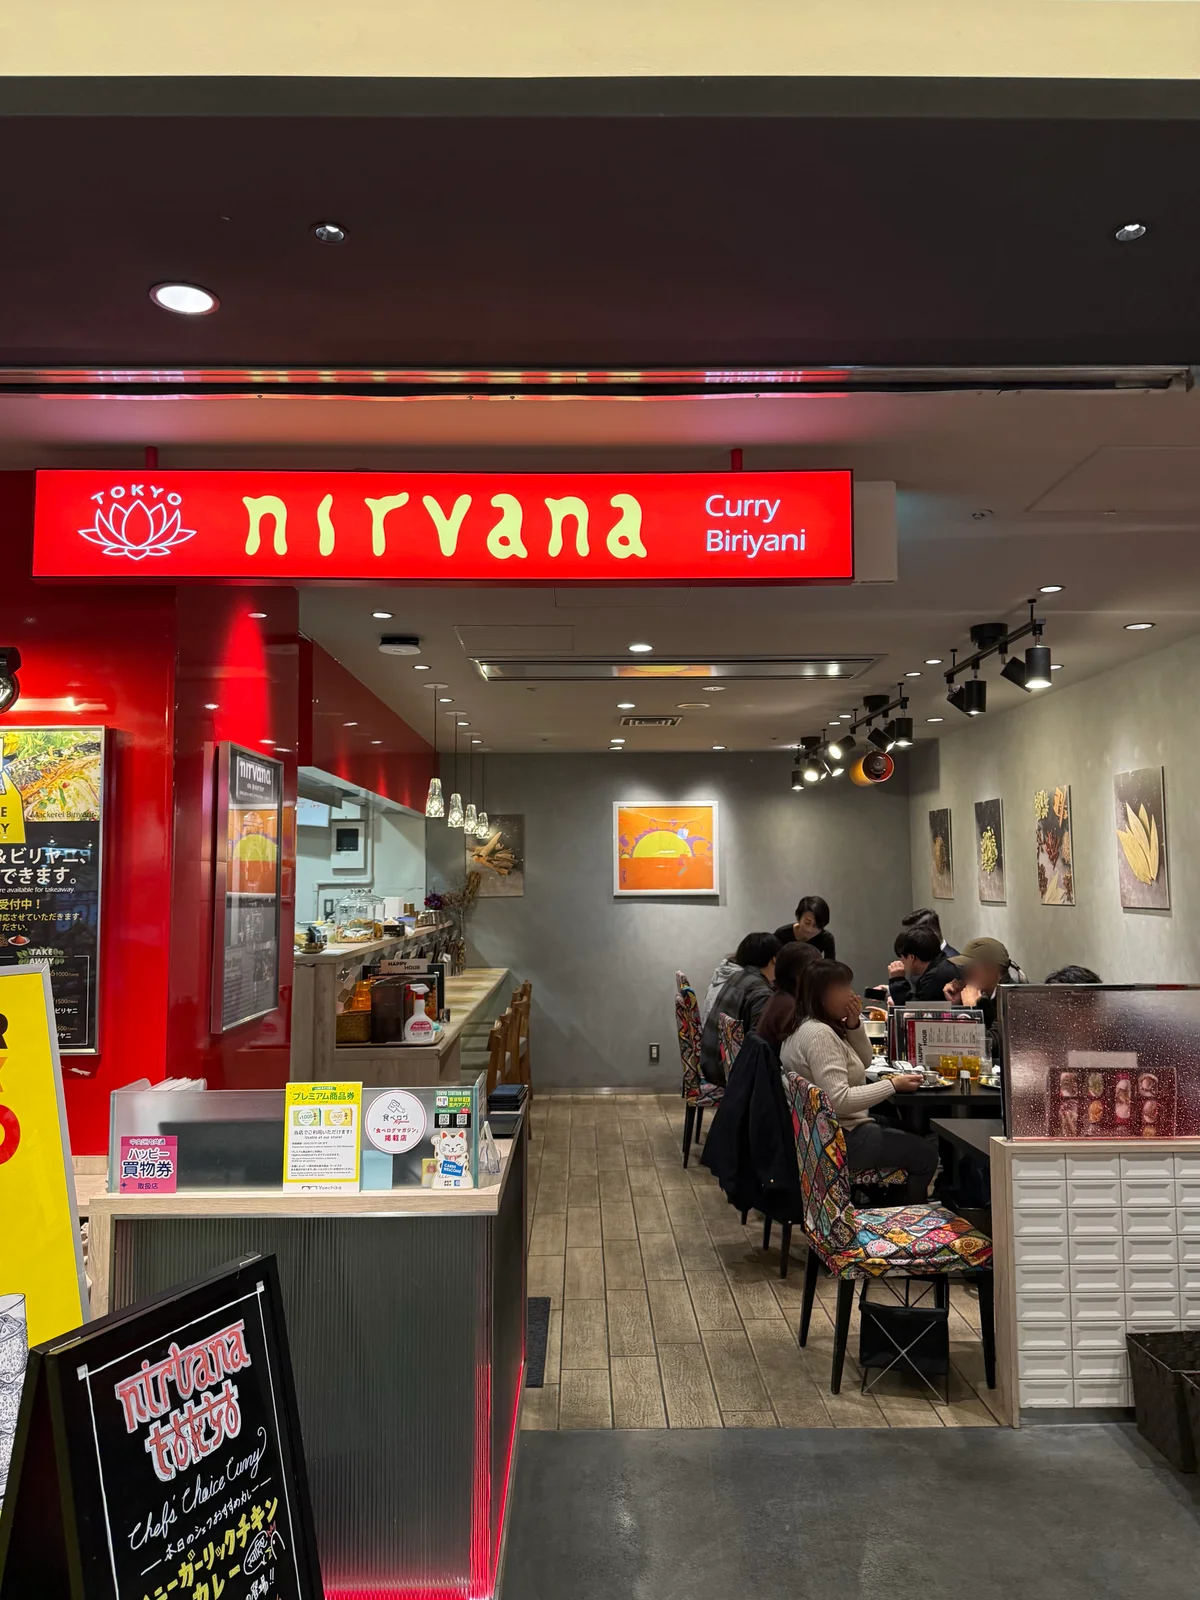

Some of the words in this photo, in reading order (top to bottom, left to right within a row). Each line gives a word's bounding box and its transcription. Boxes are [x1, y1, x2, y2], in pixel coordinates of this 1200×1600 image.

[90, 484, 182, 506] TOKYO
[705, 494, 781, 523] Curry
[242, 491, 648, 560] nirvana
[706, 528, 806, 558] Biriyani
[0, 866, 77, 885] できます。
[31, 948, 53, 956] TAKE
[293, 1091, 355, 1101] プレミアム商品券
[382, 1113, 409, 1122] 食べログ
[128, 1148, 169, 1160] ハッピー
[122, 1161, 173, 1178] 買物券
[182, 1473, 226, 1514] Choice
